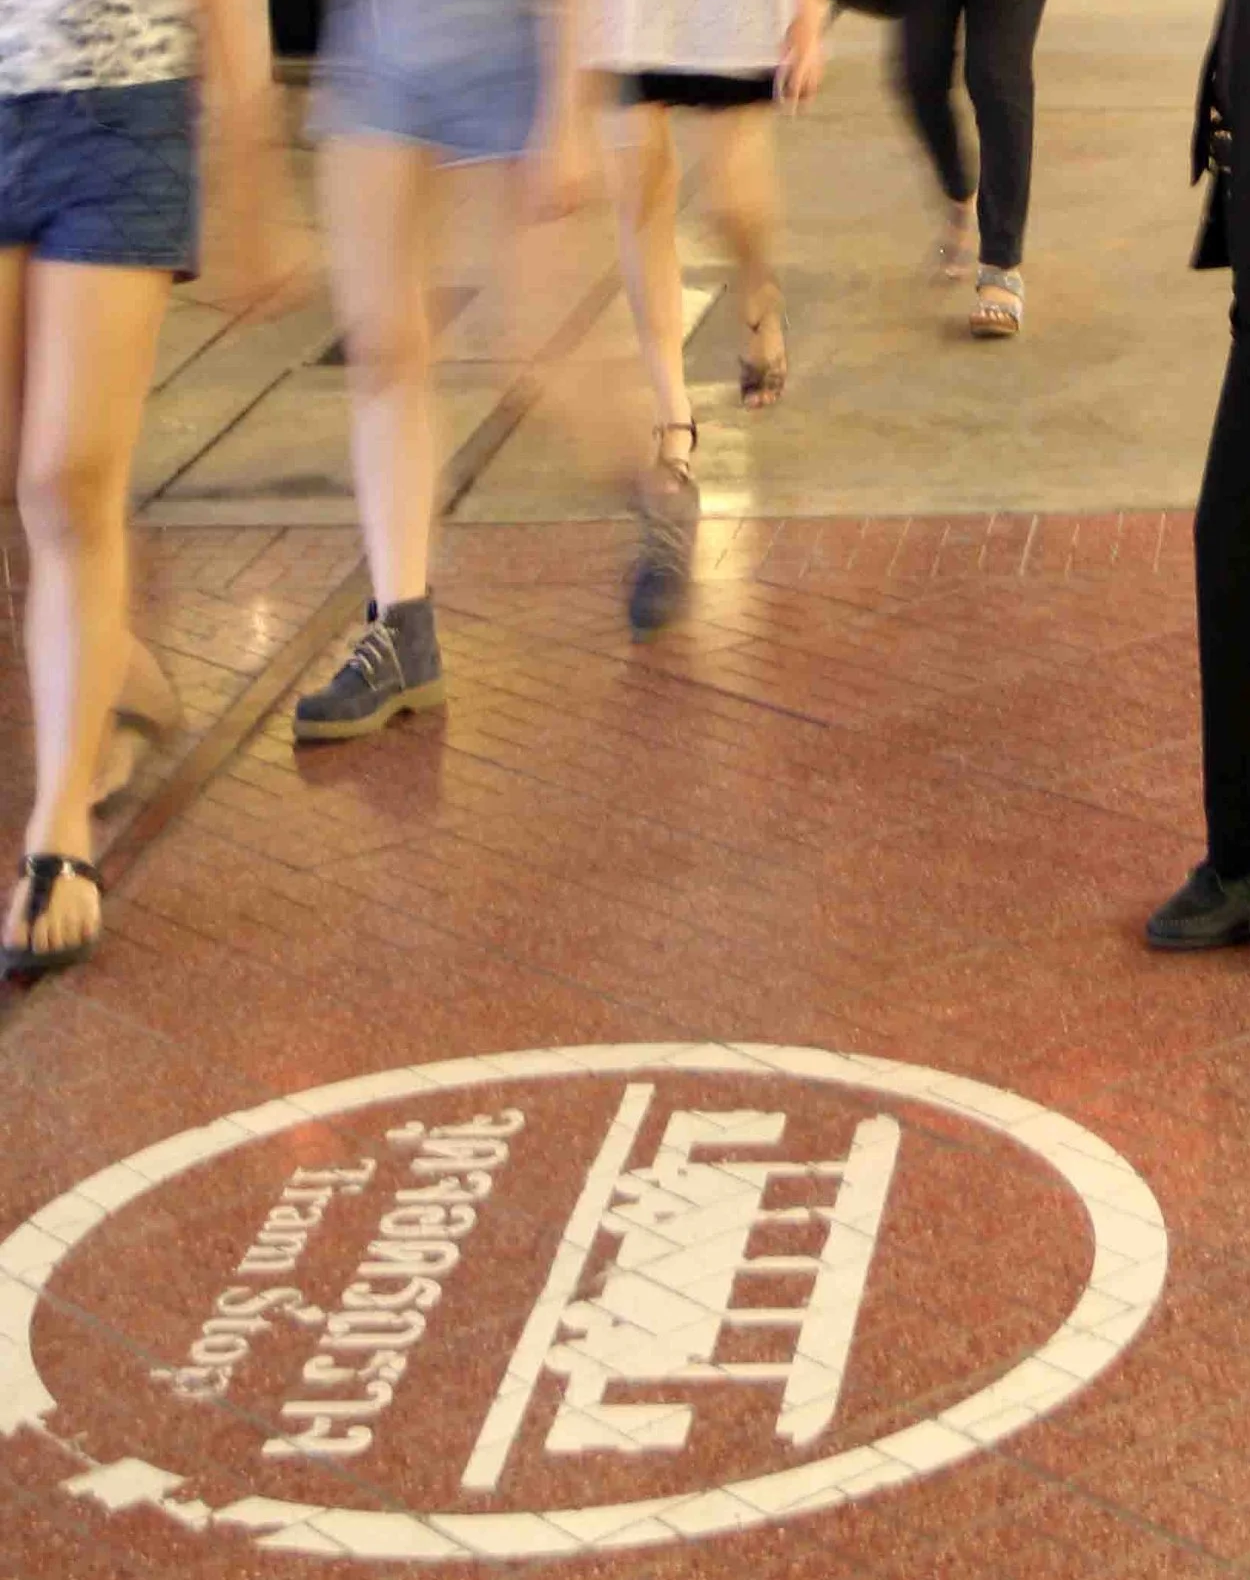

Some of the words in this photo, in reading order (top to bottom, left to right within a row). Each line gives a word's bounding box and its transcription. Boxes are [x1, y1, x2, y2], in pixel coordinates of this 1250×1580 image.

[236, 1158, 378, 1275] Tram
[261, 1107, 526, 1456] จุดจอดรถราง
[150, 1286, 326, 1397] Stop
